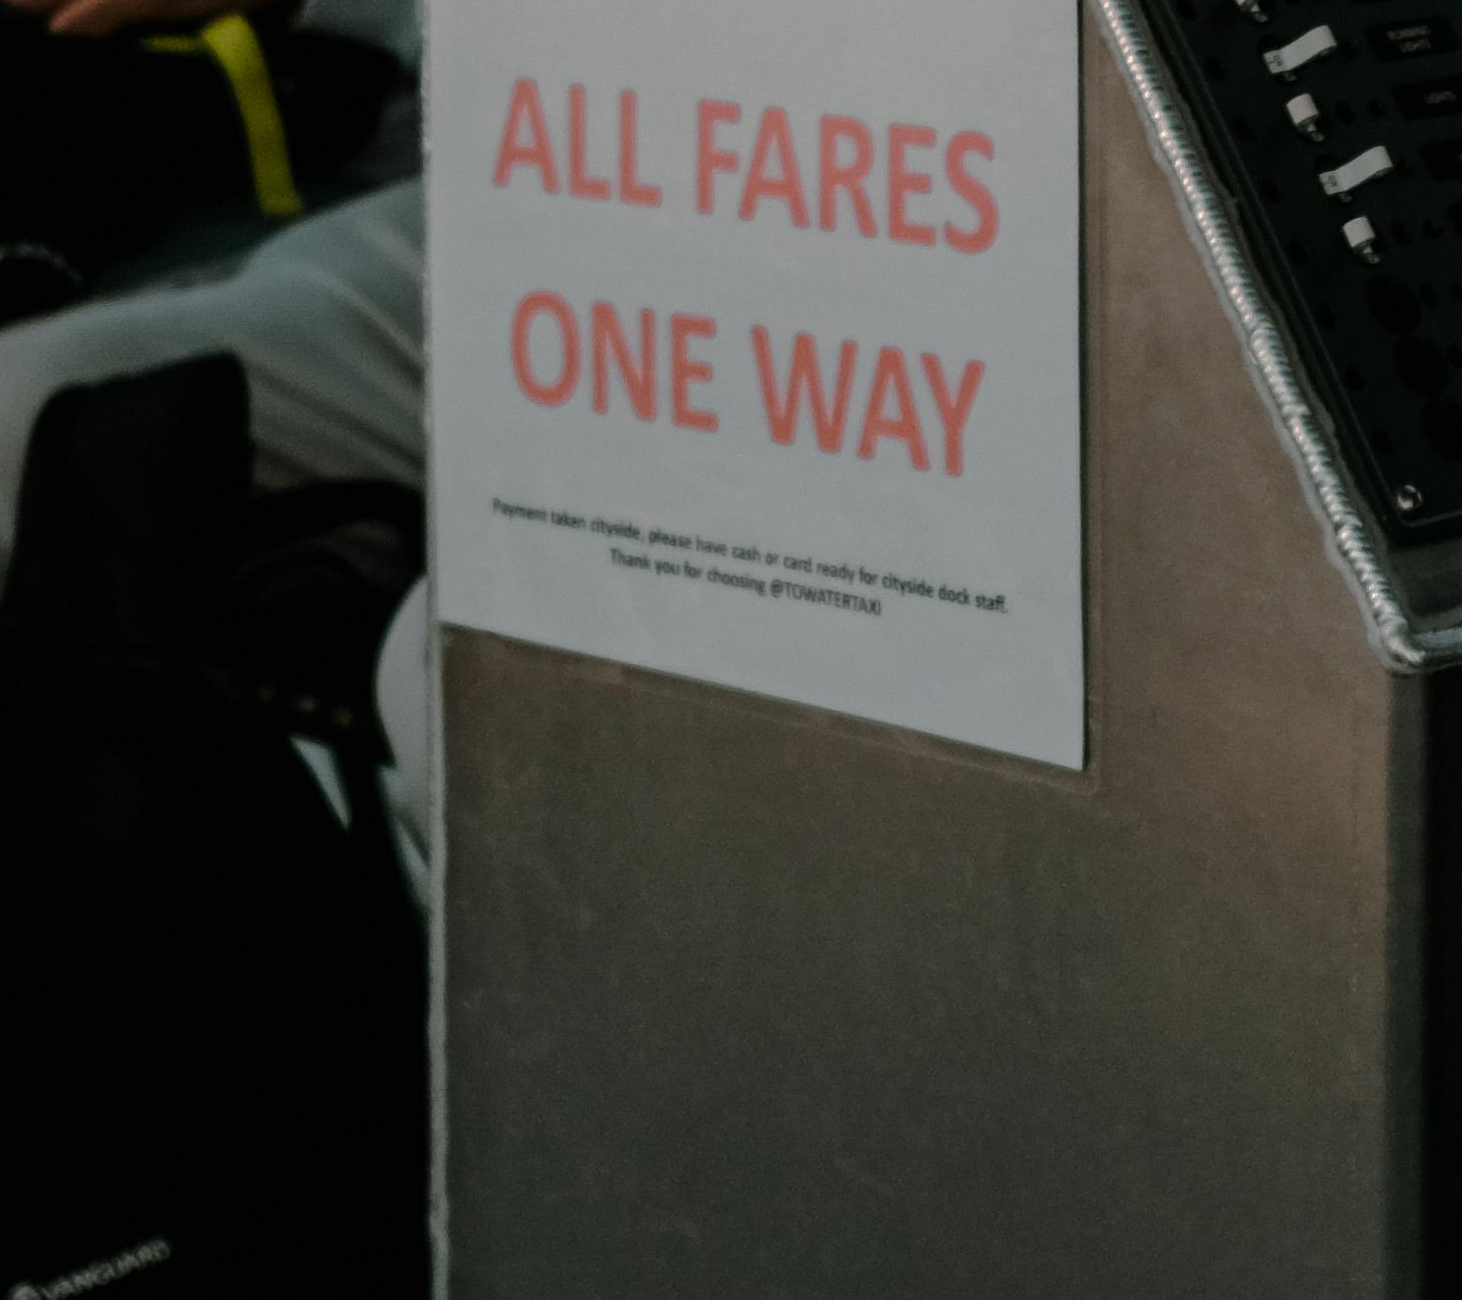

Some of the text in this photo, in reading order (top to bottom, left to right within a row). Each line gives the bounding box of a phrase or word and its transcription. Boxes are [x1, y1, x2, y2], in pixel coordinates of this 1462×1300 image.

[494, 79, 998, 253] ALL FARES
[512, 292, 983, 475] ONE WAY
[551, 510, 586, 529] taken
[648, 527, 692, 549] please
[696, 534, 727, 556] have
[765, 551, 781, 565] or
[817, 561, 855, 584] ready
[859, 565, 878, 586] for
[882, 572, 934, 598] cityside
[939, 583, 970, 605] dock
[610, 547, 650, 569] Thank
[654, 559, 680, 576] you
[683, 561, 701, 578] for
[706, 568, 767, 597] choosing
